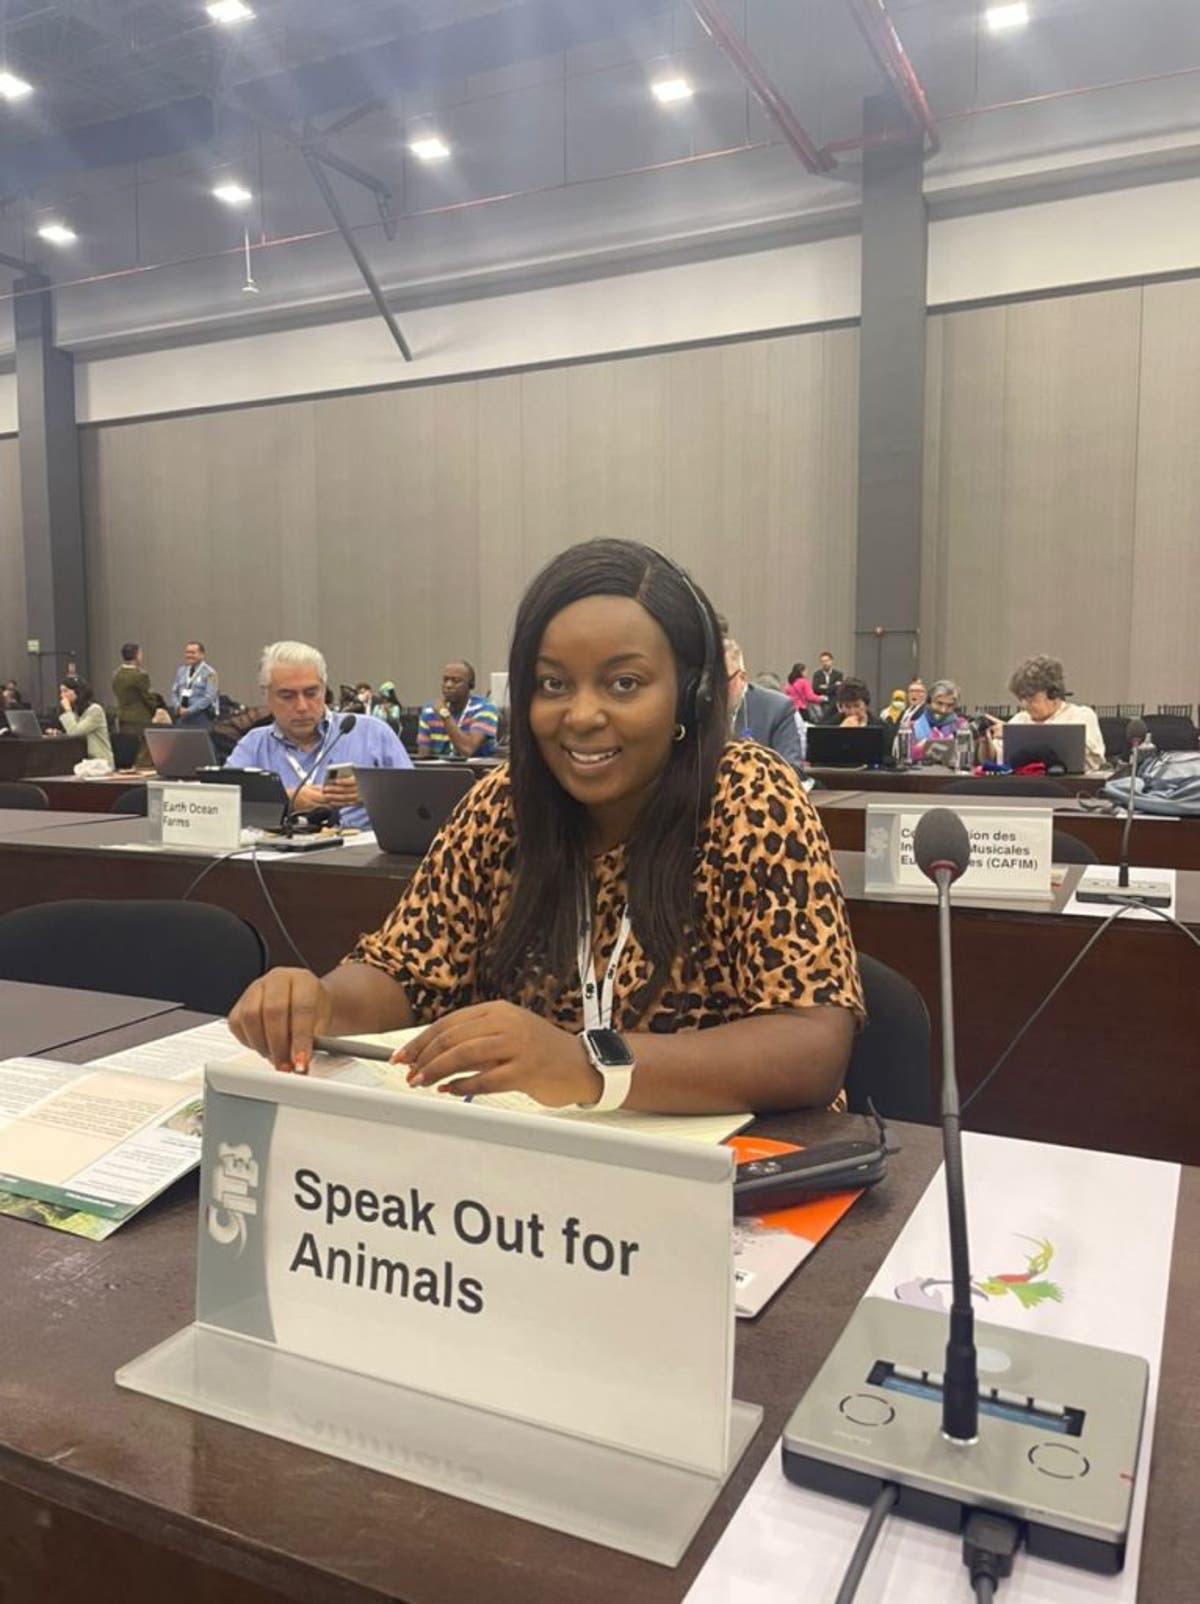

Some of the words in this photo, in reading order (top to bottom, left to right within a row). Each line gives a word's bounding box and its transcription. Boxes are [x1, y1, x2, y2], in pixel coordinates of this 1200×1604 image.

[163, 801, 187, 813] Earth
[189, 803, 218, 815] Ocean
[163, 815, 190, 828] Farms
[992, 829, 1017, 842] des
[986, 856, 1038, 870] (CAFIM)
[294, 1168, 436, 1236] Speak
[453, 1199, 544, 1259] Out
[561, 1217, 640, 1277] for
[289, 1232, 484, 1315] Animals
